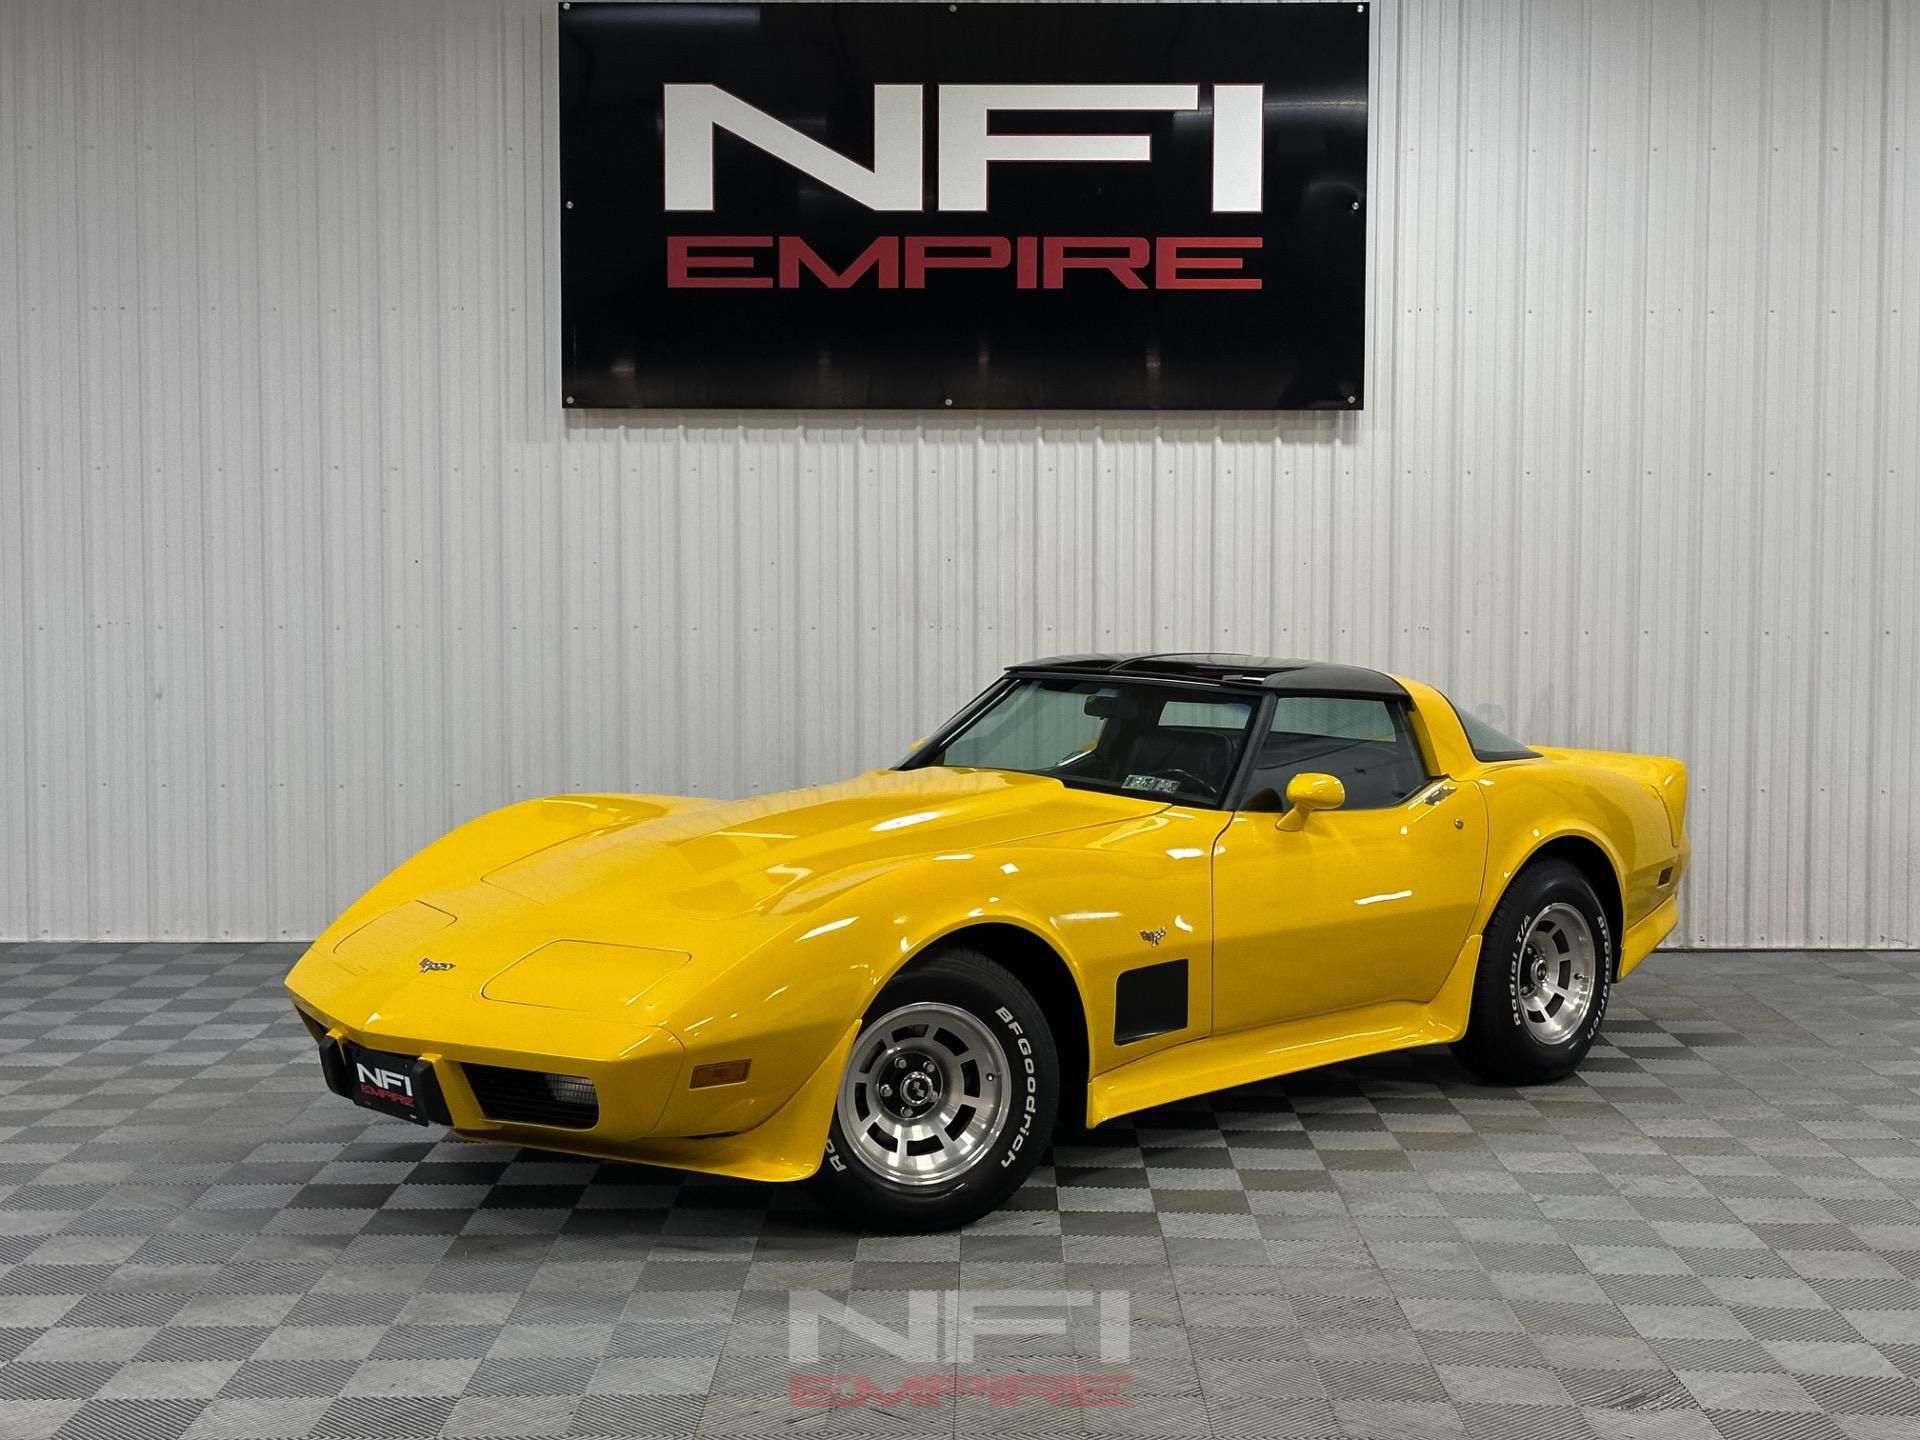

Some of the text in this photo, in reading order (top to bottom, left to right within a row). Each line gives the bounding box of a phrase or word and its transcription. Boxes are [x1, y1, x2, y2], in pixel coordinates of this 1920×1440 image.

[663, 83, 1264, 213] NFI
[666, 236, 1263, 290] EMPIRE
[356, 1062, 413, 1097] NFI
[360, 1083, 415, 1107] EMPIRE
[994, 1006, 1037, 1168] BFGoodrich
